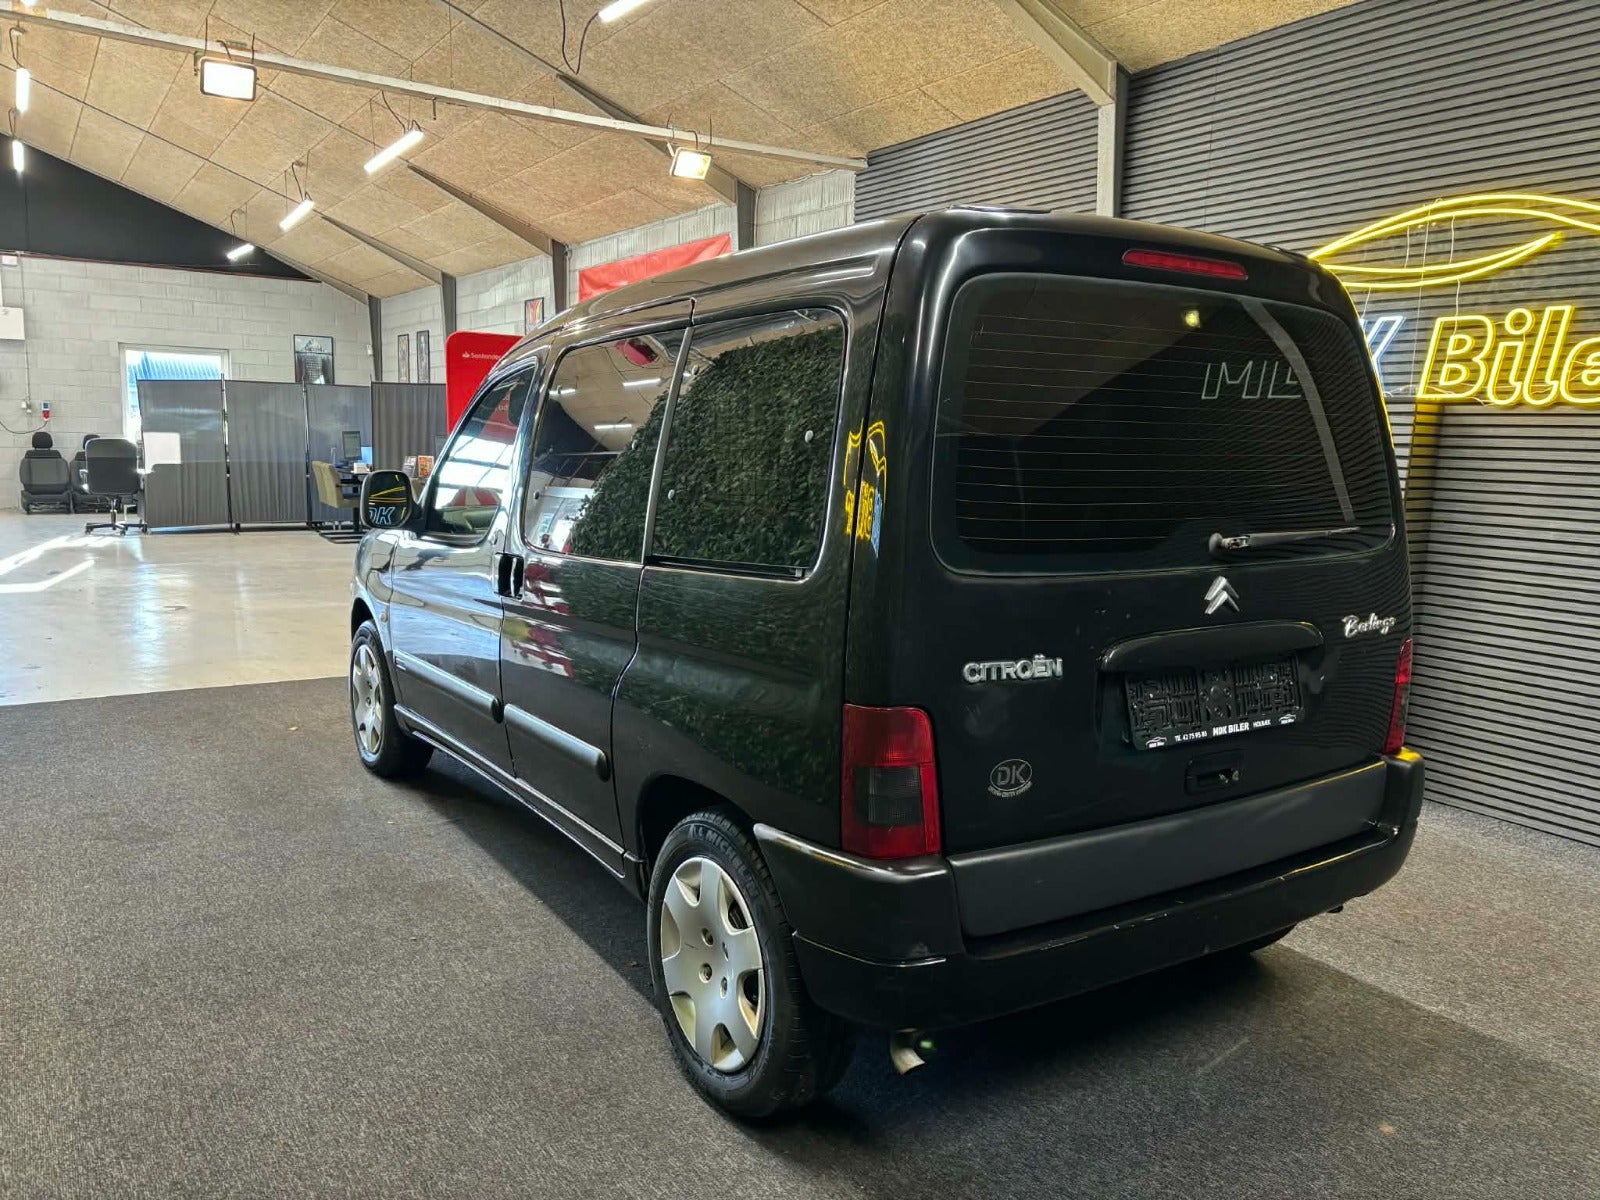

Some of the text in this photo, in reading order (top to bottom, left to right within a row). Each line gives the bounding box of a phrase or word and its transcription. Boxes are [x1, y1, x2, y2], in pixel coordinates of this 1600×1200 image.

[1341, 612, 1396, 638] Berlingo
[963, 654, 1063, 683] CITROËN
[1228, 722, 1250, 734] BILER
[997, 763, 1026, 786] DK
